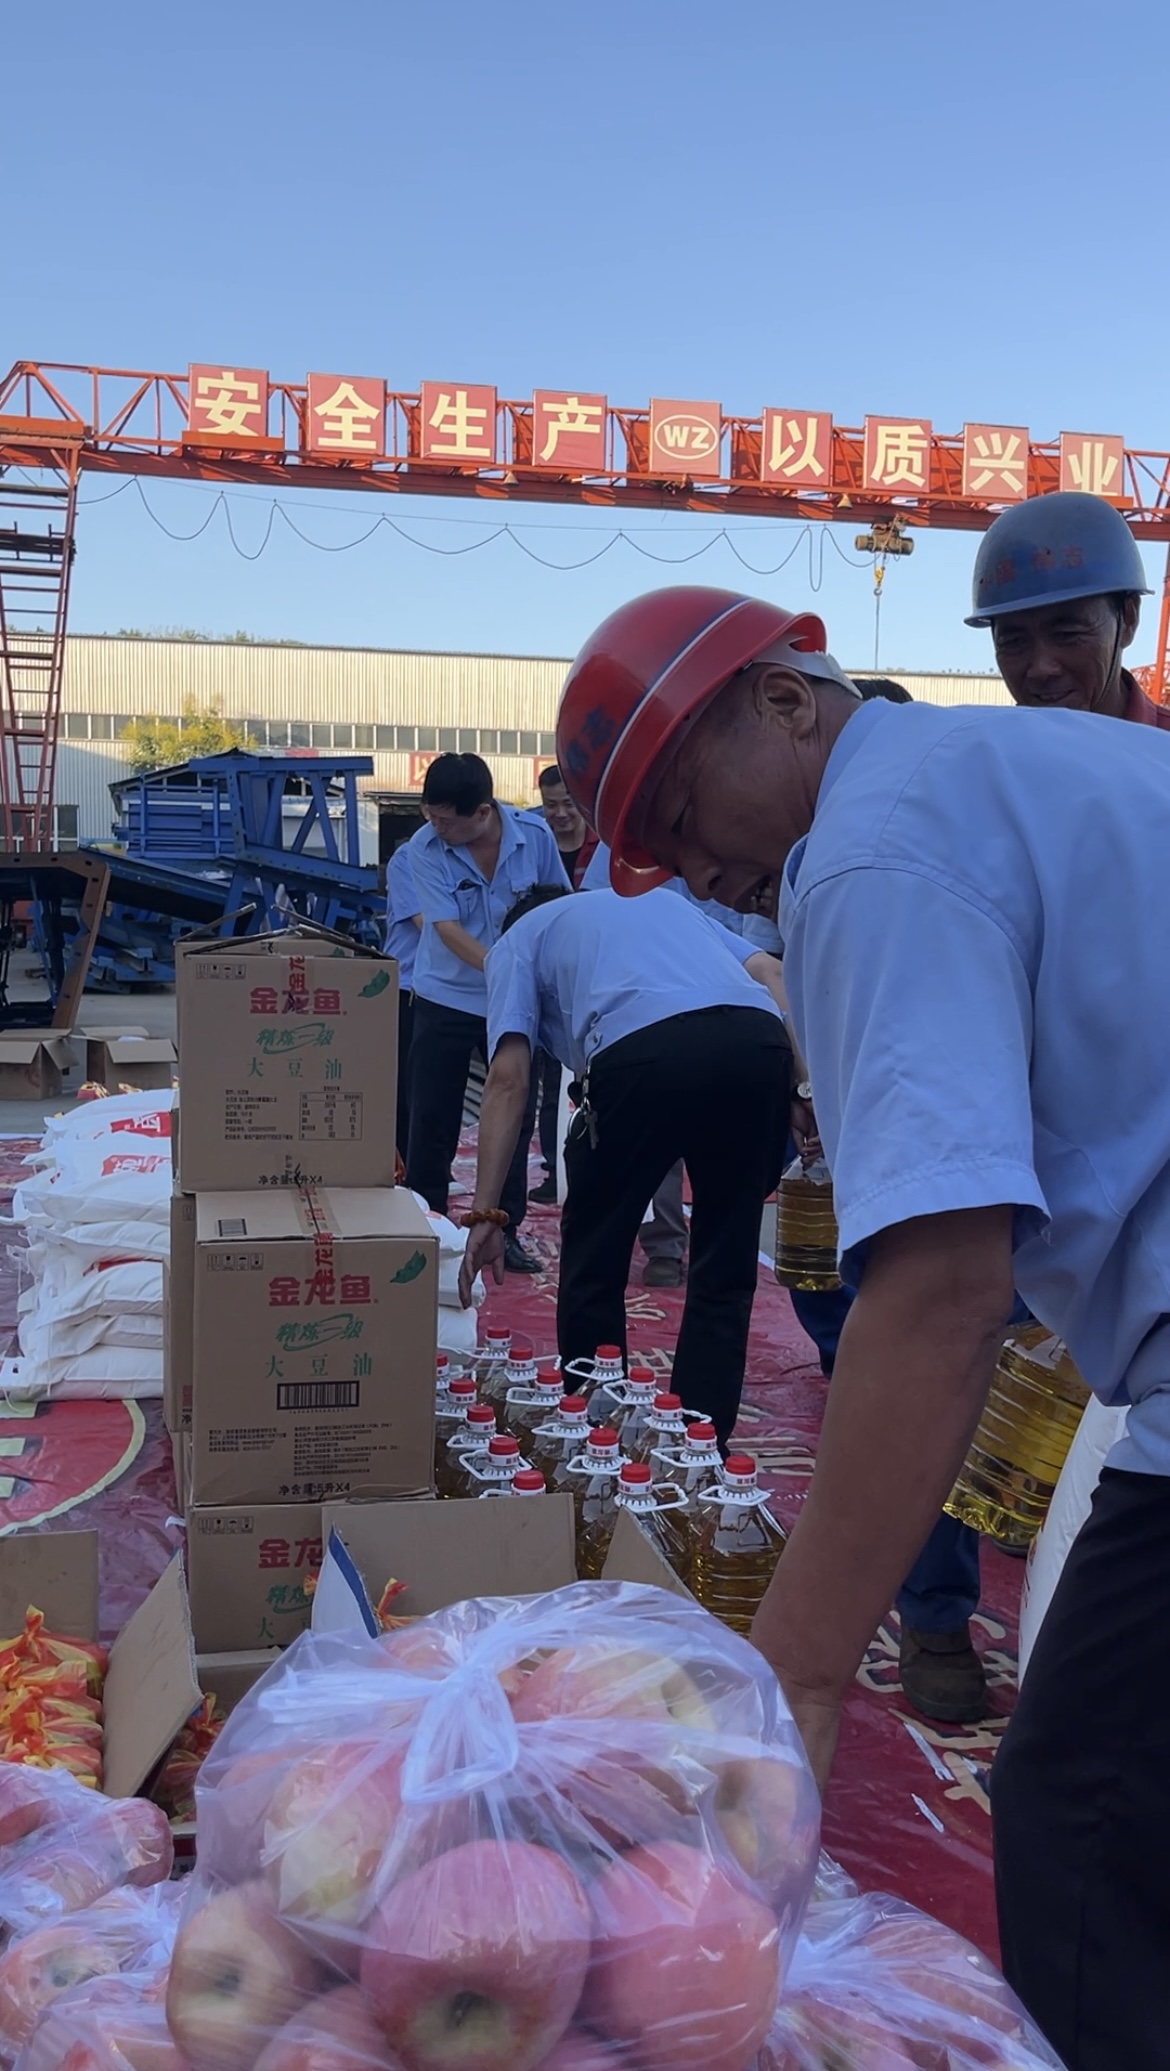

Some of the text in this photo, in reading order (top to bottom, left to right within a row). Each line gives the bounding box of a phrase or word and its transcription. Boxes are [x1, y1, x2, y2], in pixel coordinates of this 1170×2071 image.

[195, 371, 602, 461] 安全生产
[663, 423, 710, 450] WZ
[768, 415, 1118, 496] 以质兴业
[250, 987, 341, 1015] 金龙鱼
[247, 1057, 342, 1080] 大豆油
[268, 1274, 371, 1306] 金龙鱼
[265, 1352, 372, 1377] 大豆油
